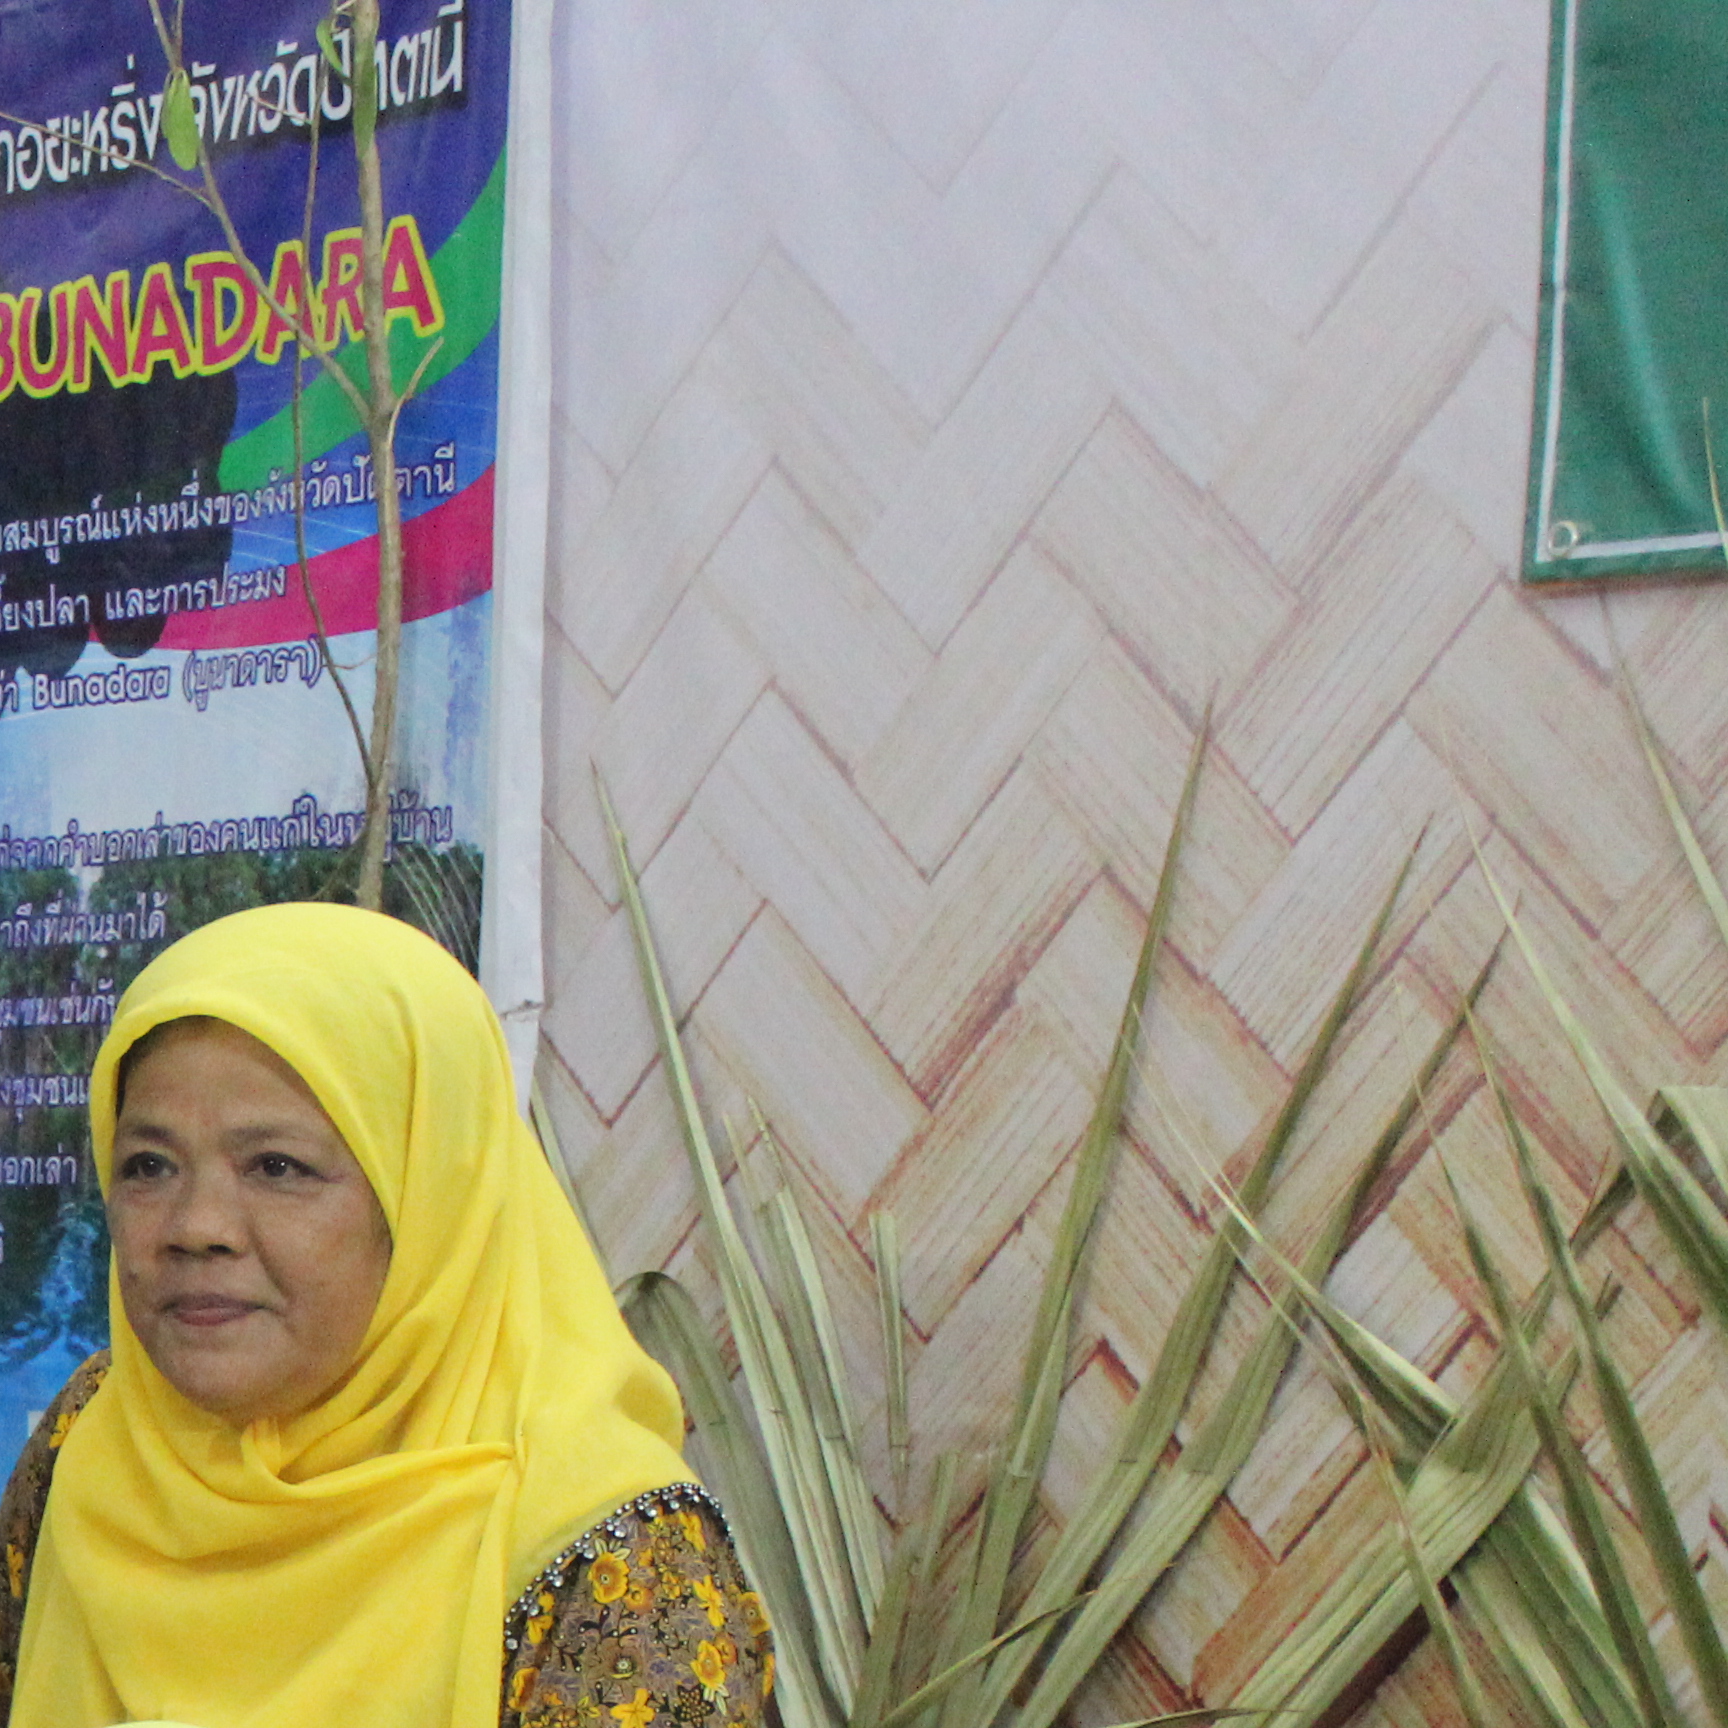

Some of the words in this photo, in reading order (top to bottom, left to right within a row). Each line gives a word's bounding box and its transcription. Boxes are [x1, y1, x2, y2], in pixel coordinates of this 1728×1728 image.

[105, 562, 287, 620] และการประมง
[32, 663, 171, 710] Bunadara
